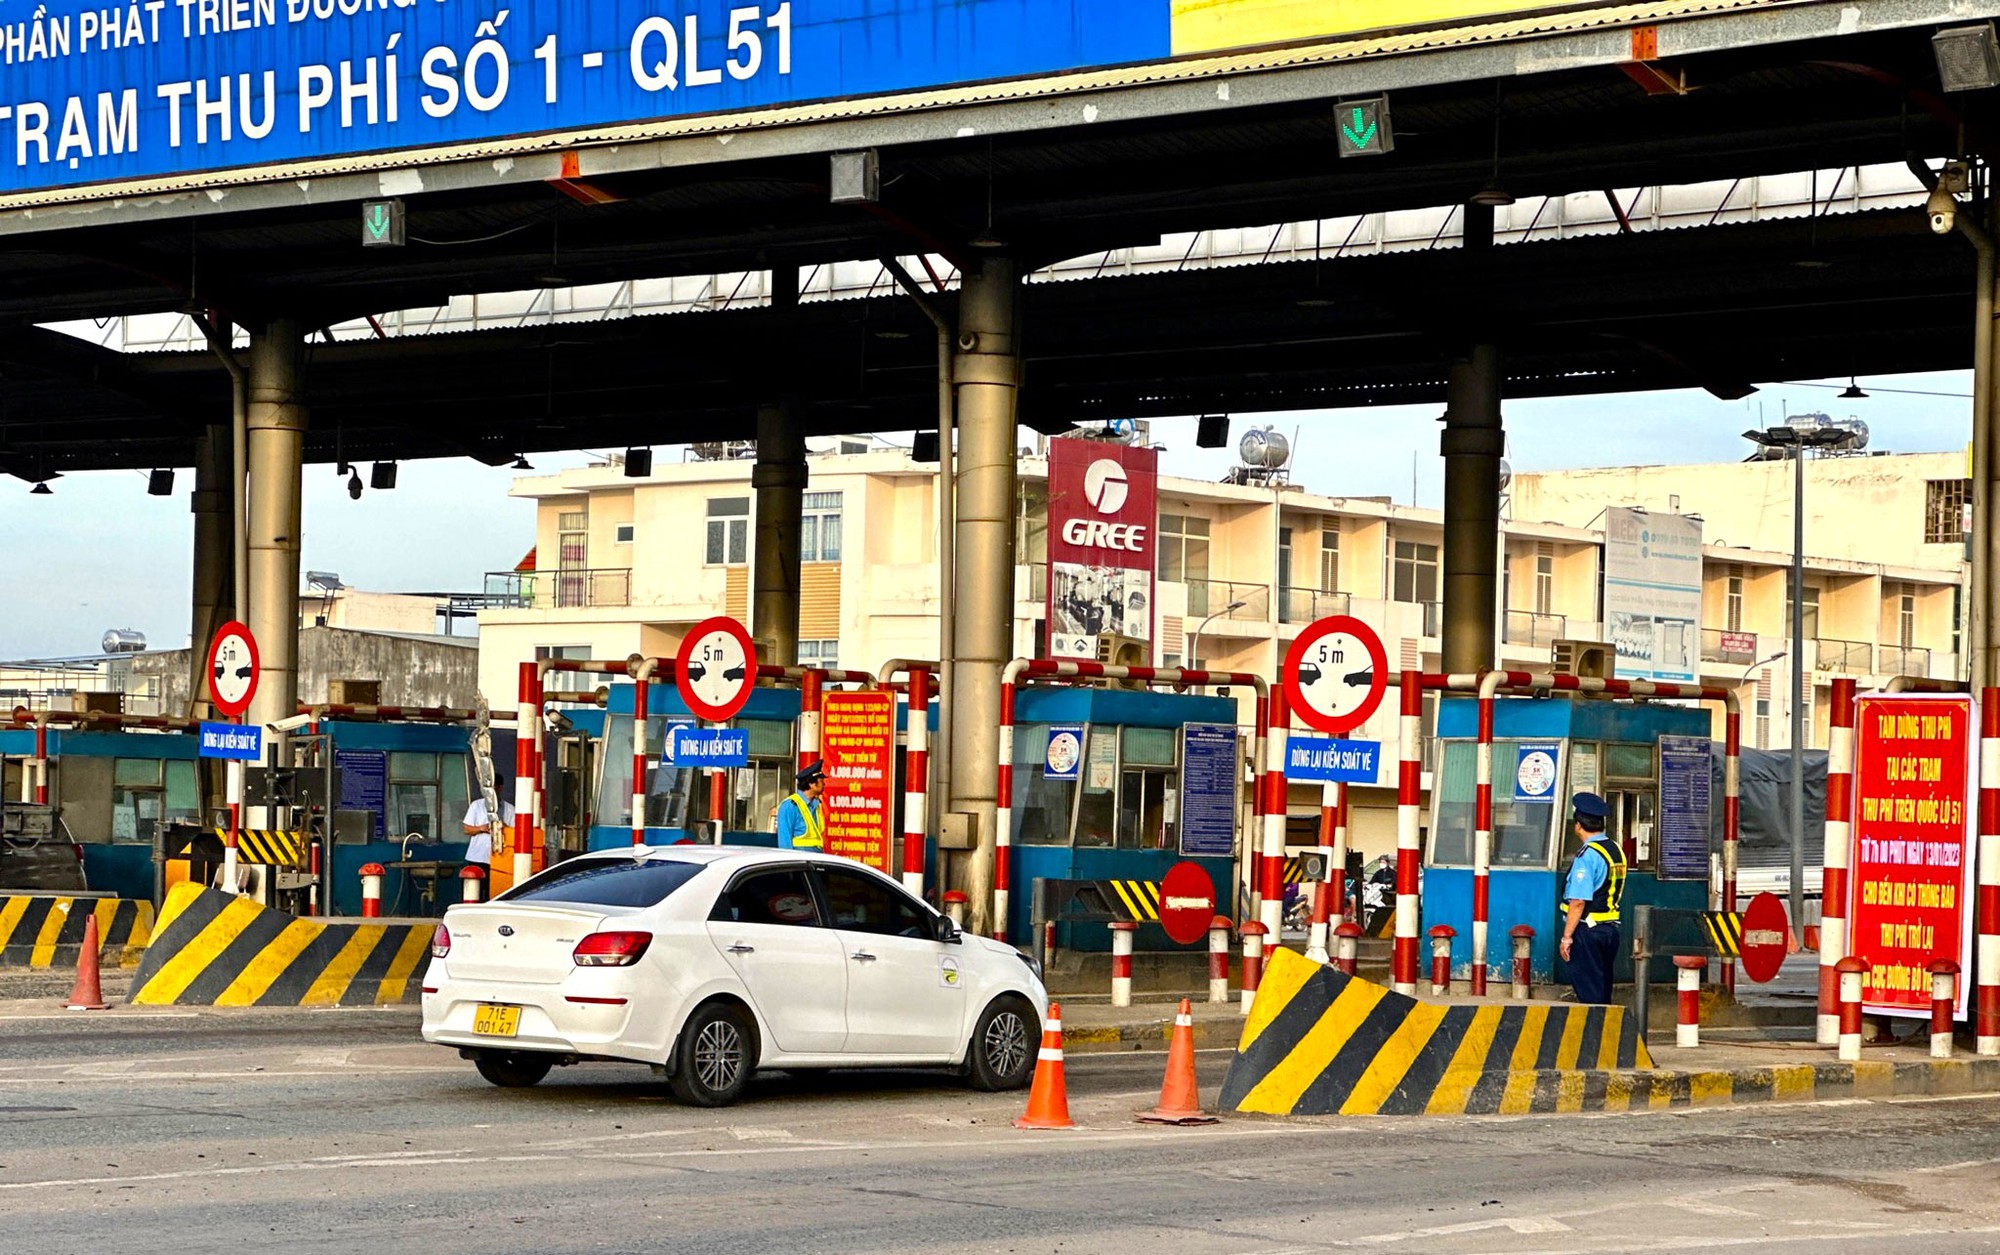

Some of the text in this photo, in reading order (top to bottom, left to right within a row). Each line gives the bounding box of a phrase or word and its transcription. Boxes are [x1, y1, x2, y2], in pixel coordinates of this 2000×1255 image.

[0, 5, 70, 64] HẦN
[157, 70, 275, 147] THU
[298, 32, 402, 133] PHÍ
[420, 9, 510, 118] SỐ
[534, 34, 557, 104] 1
[582, 51, 603, 68] -
[629, 1, 791, 92] QL51
[1061, 518, 1147, 553] GREE
[223, 646, 228, 661] 5
[703, 645, 723, 661] 5 m
[1318, 645, 1344, 664] 5 m
[1878, 710, 1952, 744] TẠM DỪNG THU PHÍ
[680, 735, 699, 756] DỪNG
[699, 739, 708, 758] LẠI
[723, 735, 737, 756] SOÁT
[736, 735, 743, 756] VÉ
[1291, 743, 1372, 774] DỪNG LẠI KIỂM SOÁT VÉ
[829, 766, 866, 779] 4.000.000
[1886, 752, 1942, 787] TẠI CÁC TRẠM
[829, 795, 865, 808] 6.000.000
[1862, 791, 1961, 830] THU PHÍ TRÊN QUỐC LỘ 51
[1861, 834, 1871, 863] TỪ
[1879, 840, 1889, 864] 00
[1889, 836, 1906, 864] PHÚT
[1906, 836, 1925, 865] NGÀY
[1925, 842, 1961, 867] 13/01/2023
[1863, 874, 1955, 909] CHO ĐẾN KHI CÓ THÔNG BÁO
[1880, 916, 1934, 955] THU PHÍ TRỞ LẠI
[1872, 964, 1887, 994] CỤC
[1887, 960, 1910, 991] ĐƯỜNG
[1911, 962, 1922, 997] BỘ
[477, 1020, 512, 1034] 001.47
[488, 1007, 507, 1020] 71E
